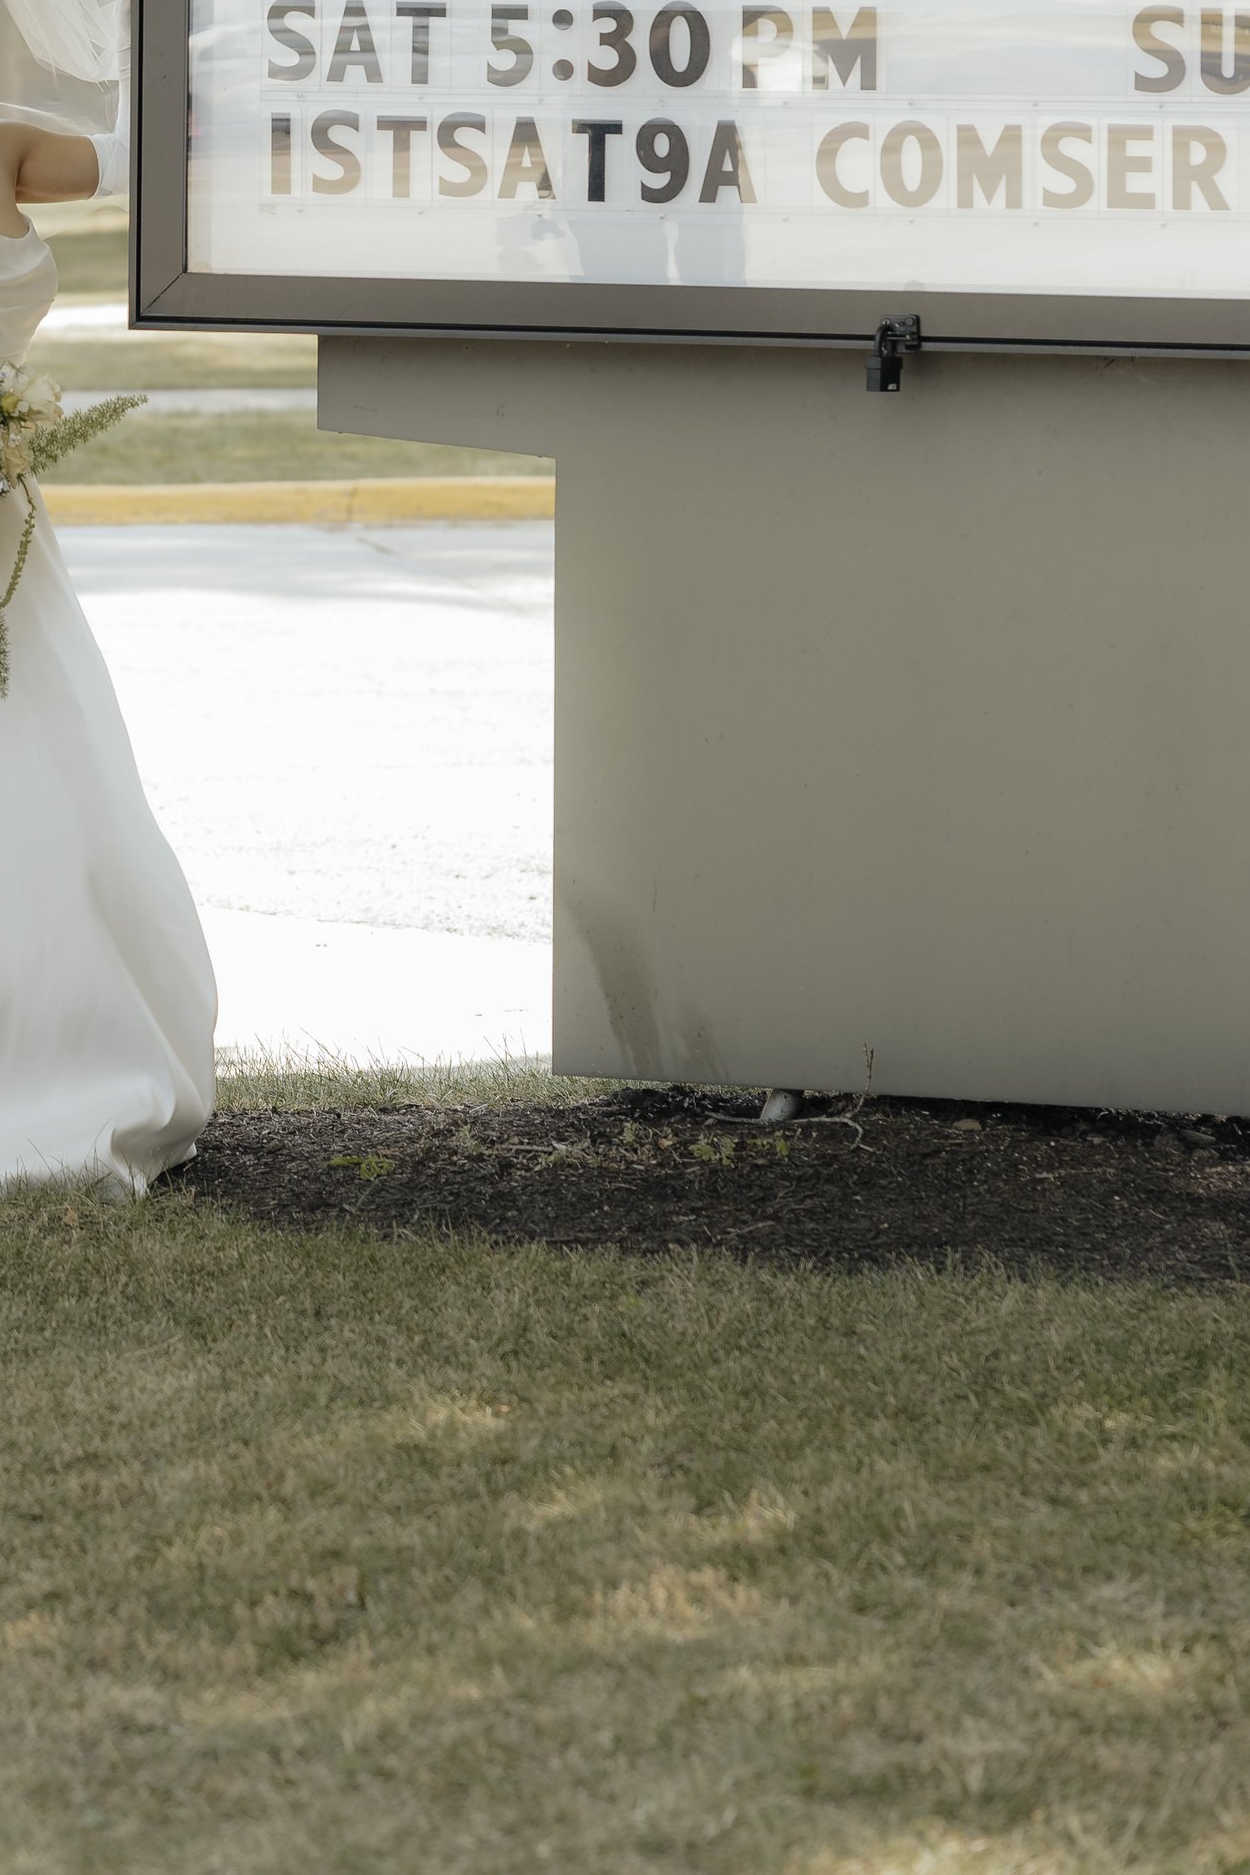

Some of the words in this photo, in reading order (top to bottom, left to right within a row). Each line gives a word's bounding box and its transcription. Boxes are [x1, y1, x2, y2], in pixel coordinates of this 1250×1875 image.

[486, 0, 711, 88] 5:30
[741, 4, 878, 91] PM
[816, 120, 1231, 211] COMSER
